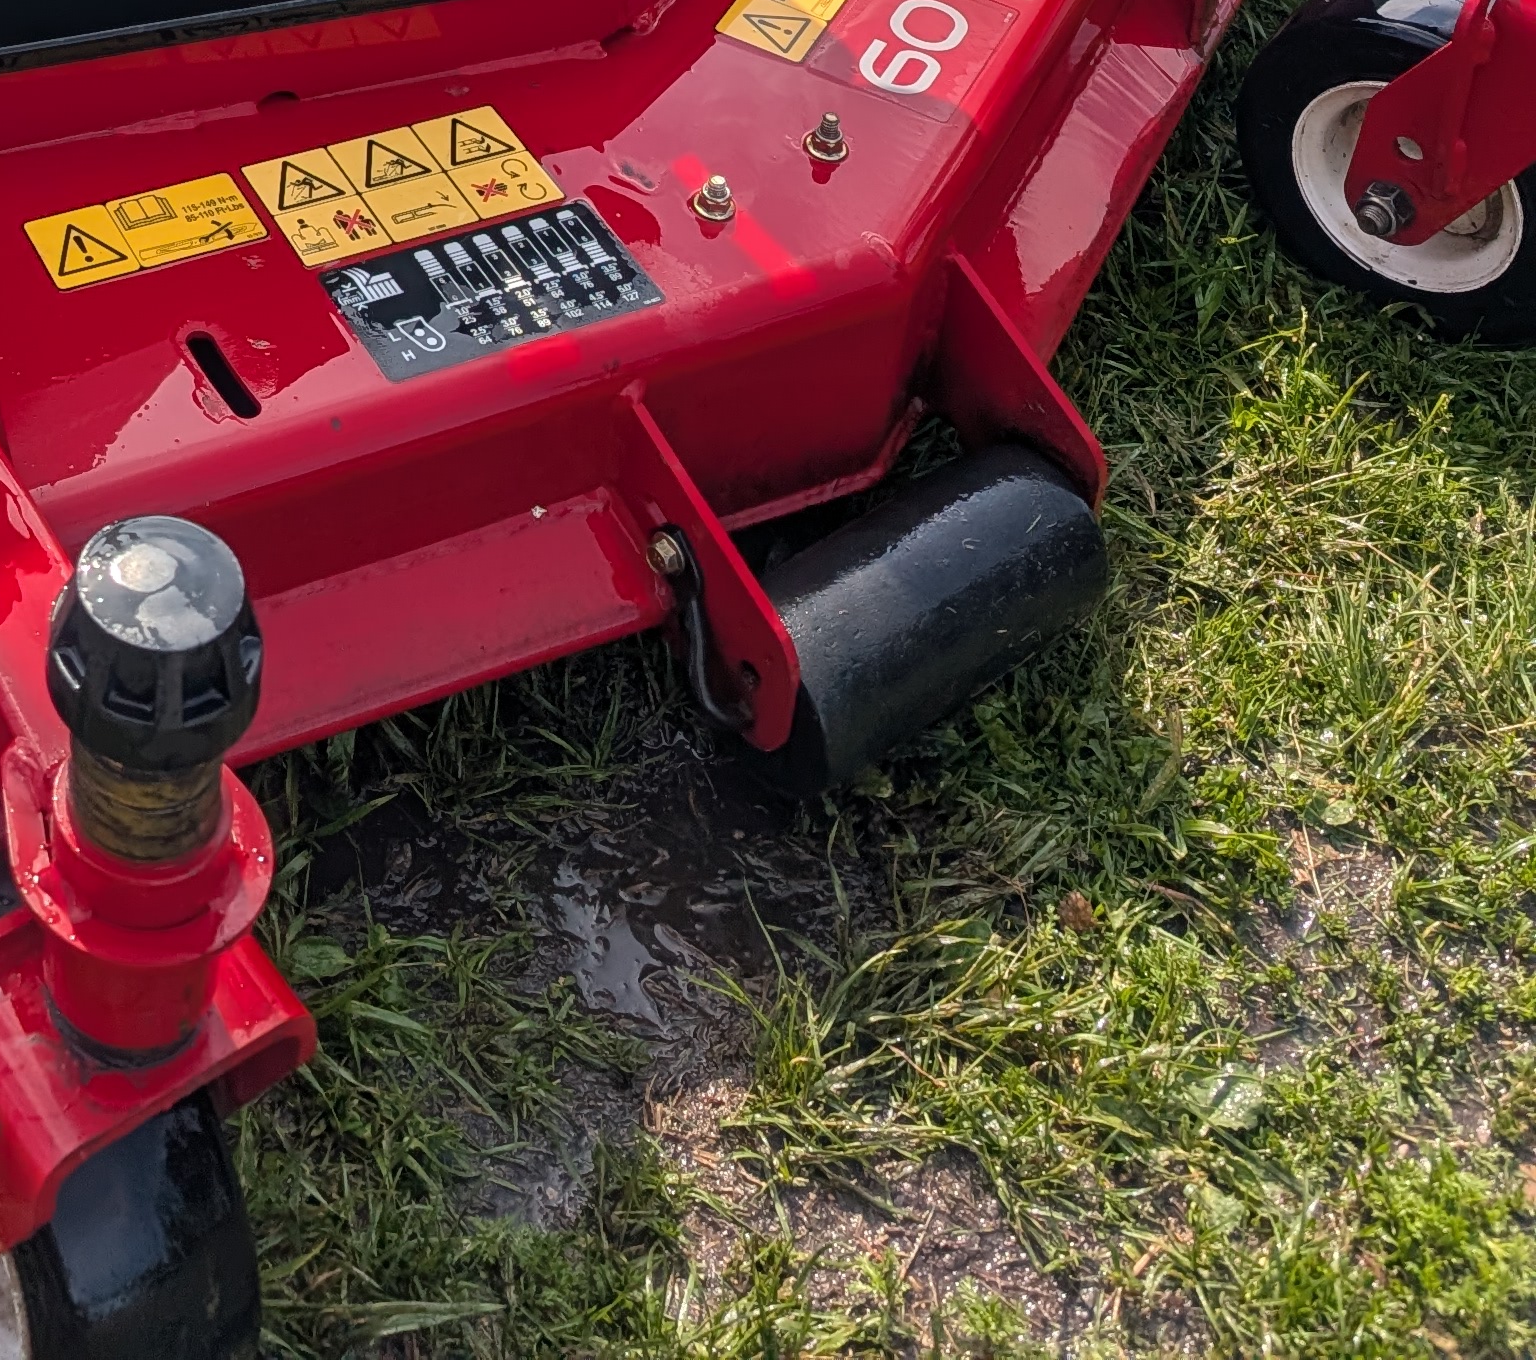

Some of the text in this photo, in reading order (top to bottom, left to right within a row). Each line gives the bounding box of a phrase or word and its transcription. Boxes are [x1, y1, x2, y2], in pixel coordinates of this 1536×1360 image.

[185, 209, 214, 222] 85-110
[523, 298, 537, 307] 51
[580, 280, 595, 289] 76
[478, 335, 492, 345] 64
[537, 318, 551, 328] 89
[564, 309, 584, 318] 102
[593, 300, 613, 310] 114
[622, 292, 640, 302] 127
[388, 332, 402, 343] L
[401, 349, 416, 361] H
